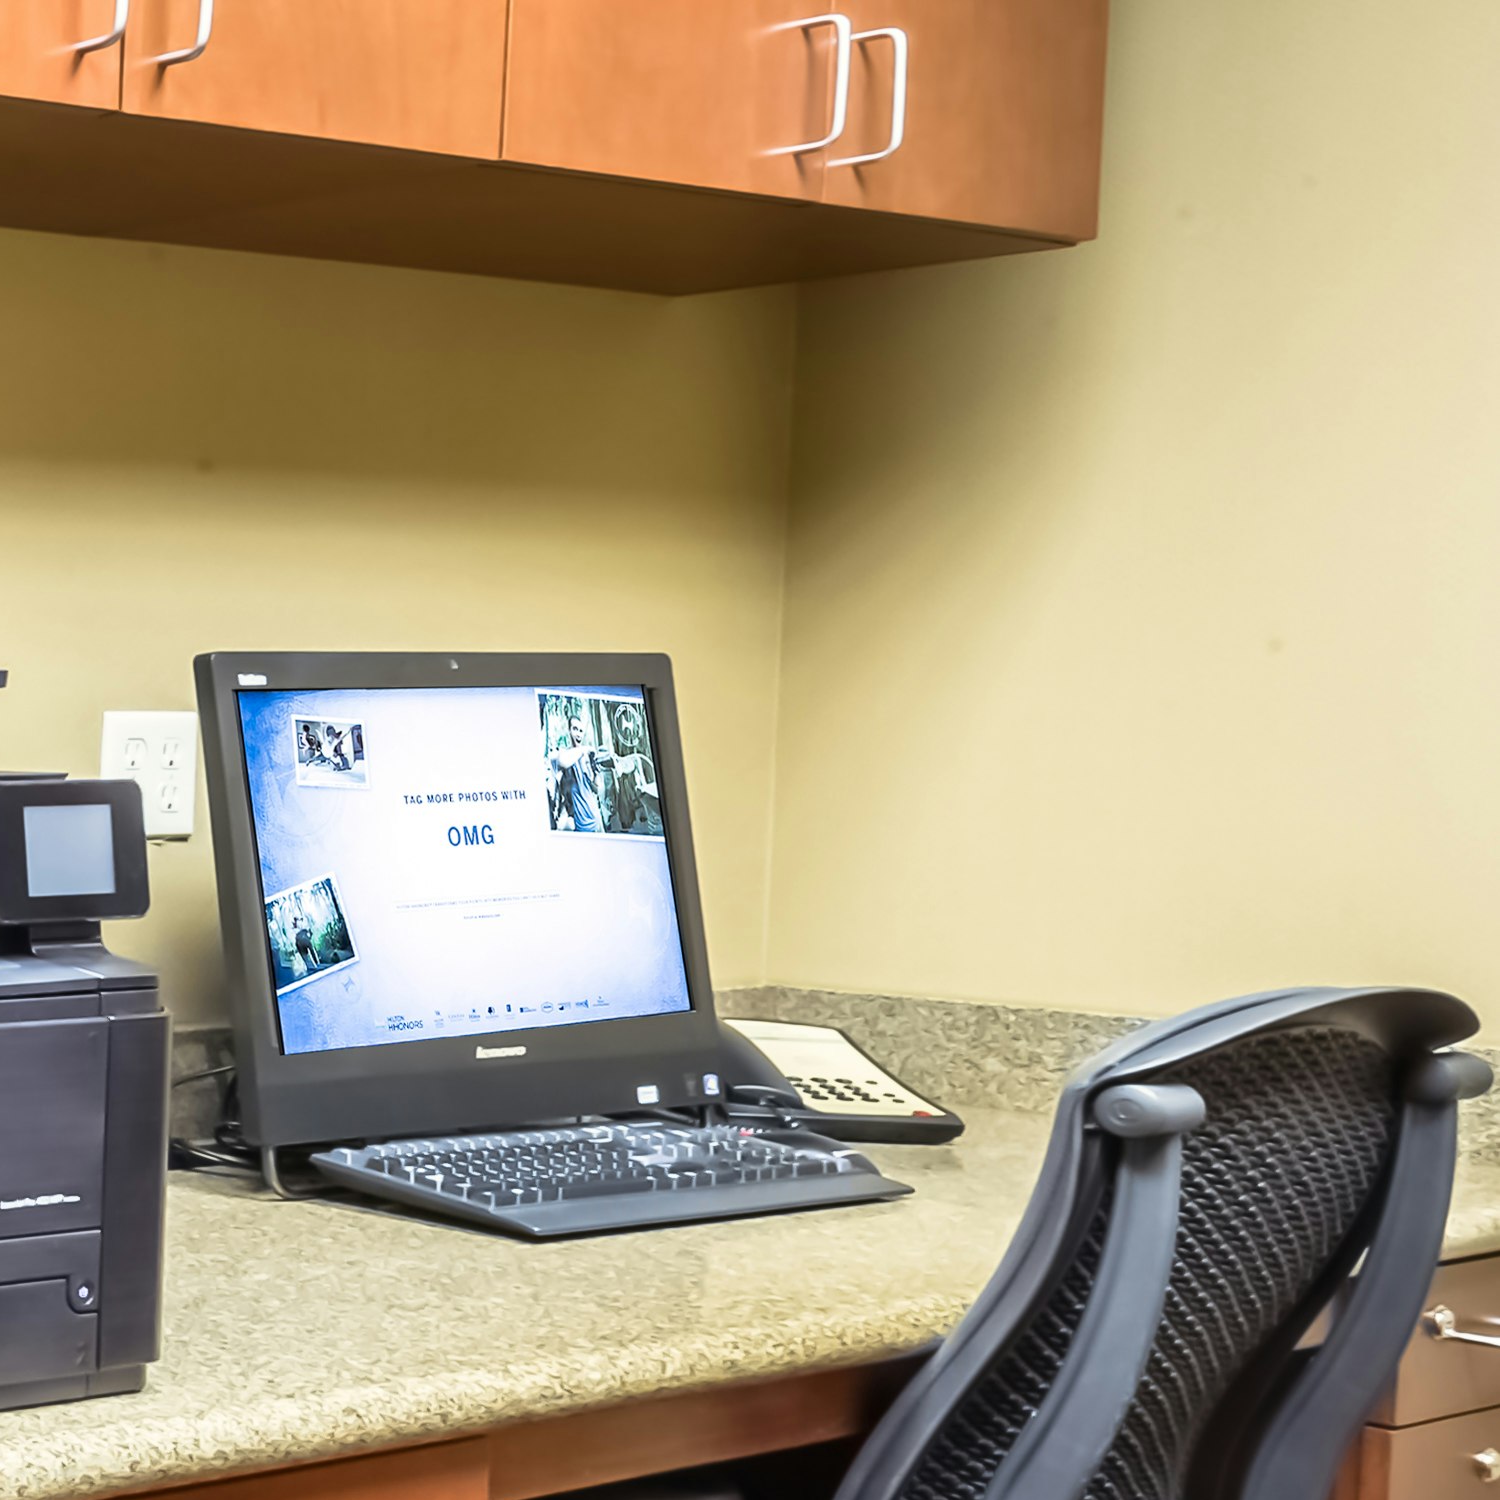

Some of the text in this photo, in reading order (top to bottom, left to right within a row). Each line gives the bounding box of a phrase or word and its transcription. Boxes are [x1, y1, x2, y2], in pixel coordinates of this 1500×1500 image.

[403, 789, 526, 805] TAG MORE PHOTOS WITH
[447, 824, 495, 847] OMG
[388, 1020, 424, 1031] HHONORS
